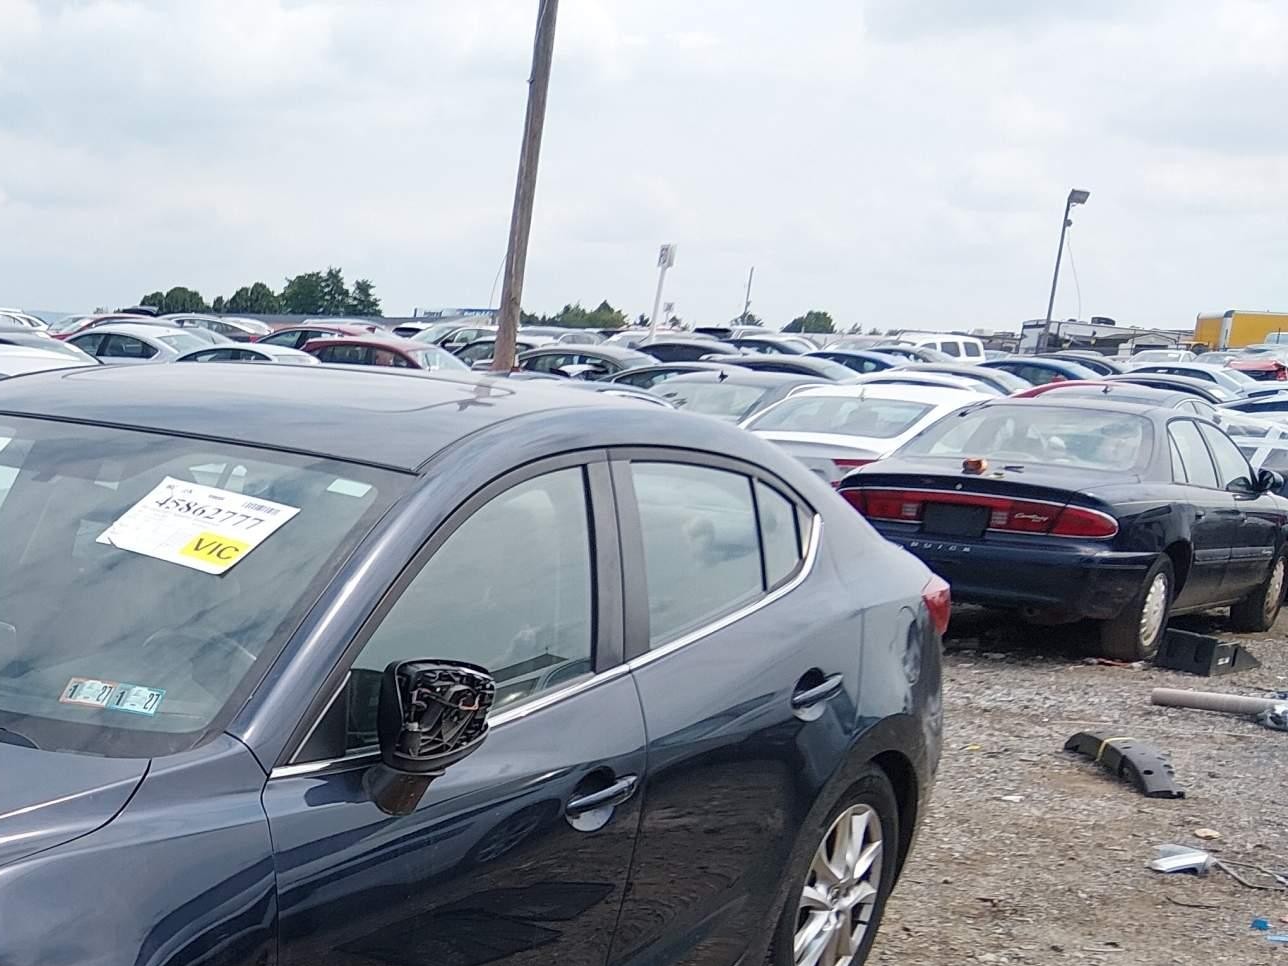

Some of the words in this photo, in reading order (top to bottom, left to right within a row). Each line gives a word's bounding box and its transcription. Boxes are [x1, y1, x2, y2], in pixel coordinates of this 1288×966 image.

[155, 496, 264, 530] 45862777
[193, 537, 239, 560] VIC
[69, 684, 79, 699] 1
[115, 690, 126, 706] 1
